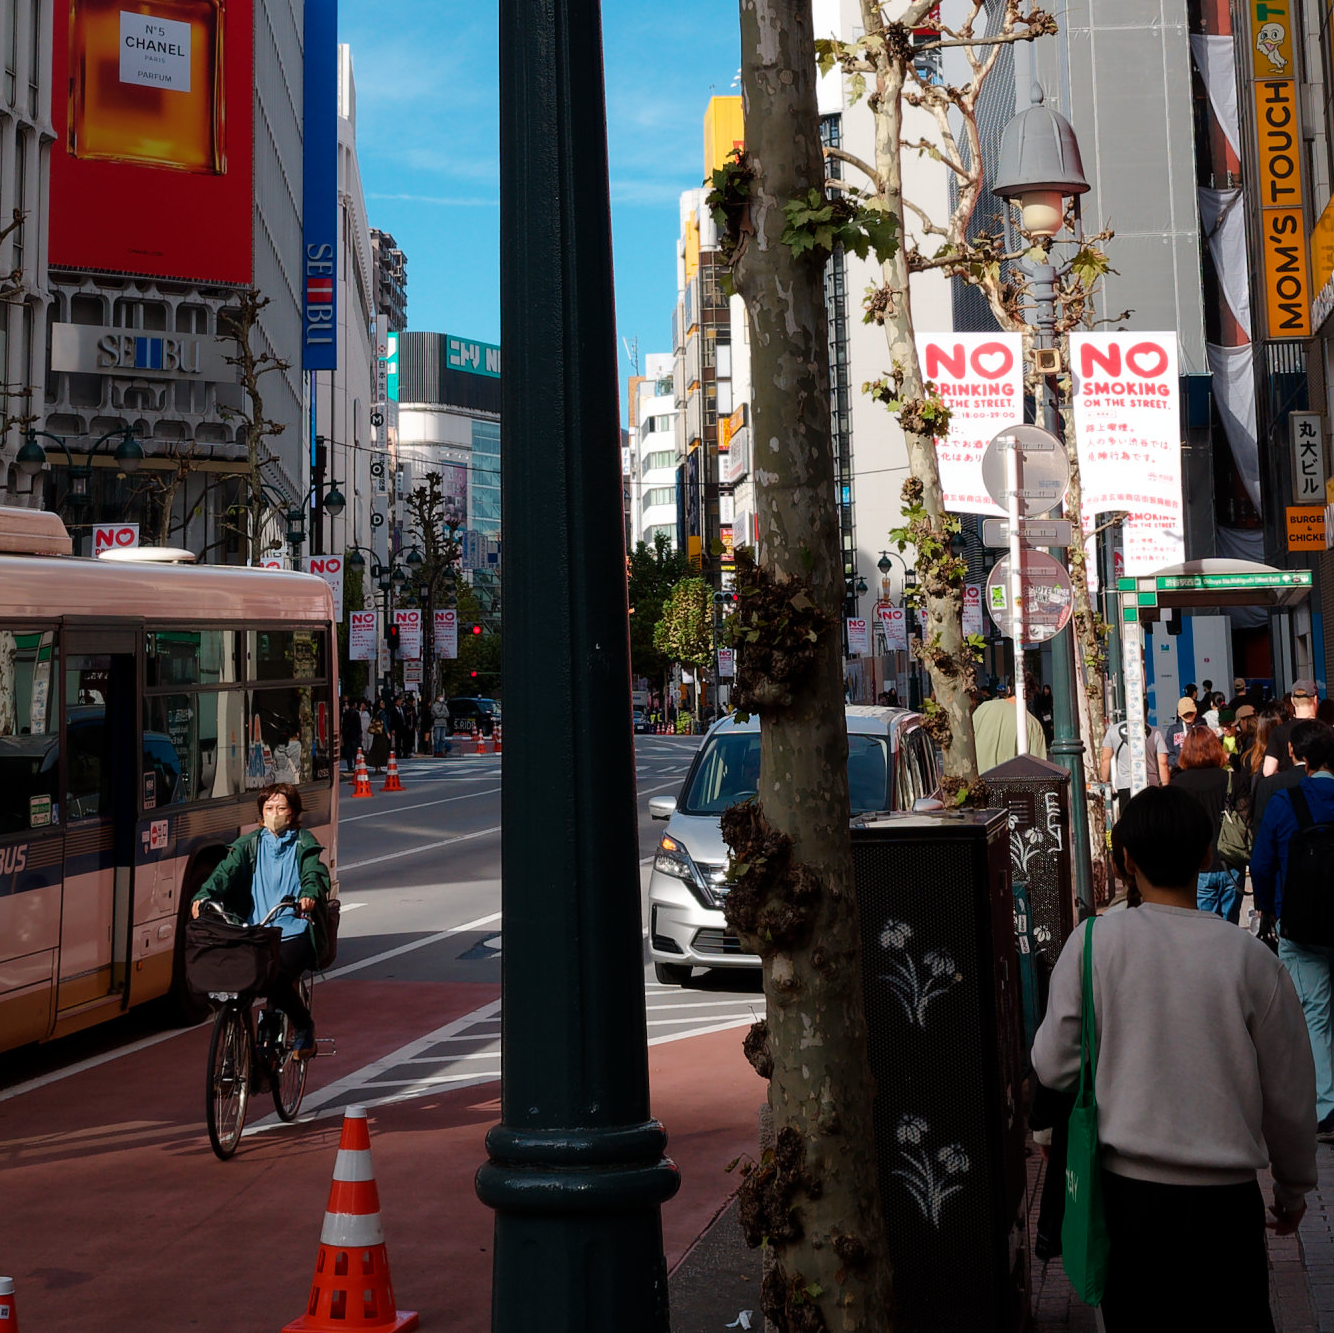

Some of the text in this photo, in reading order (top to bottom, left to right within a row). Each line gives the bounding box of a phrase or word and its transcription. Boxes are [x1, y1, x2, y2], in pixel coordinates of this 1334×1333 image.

[125, 36, 185, 57] CHANEL
[144, 55, 166, 64] PARIS
[137, 70, 172, 83] PARFUM
[1265, 82, 1295, 204] TOUCH
[1272, 214, 1305, 330] MOM'S
[306, 242, 333, 346] SEIBU
[97, 334, 202, 374] SEIBU
[449, 339, 480, 370] ニトリ
[925, 341, 1014, 380] NO
[1080, 341, 1169, 379] NO
[1082, 382, 1171, 397] SMOKING
[974, 398, 1016, 408] STREET.
[1083, 398, 1171, 411] ON THE STREET.
[1298, 420, 1320, 495] 丸大ビル
[95, 528, 135, 547] NO
[310, 558, 341, 575] NO
[352, 613, 374, 623] NO
[396, 611, 419, 622] NO
[434, 612, 455, 622] NO
[882, 610, 903, 620] NO
